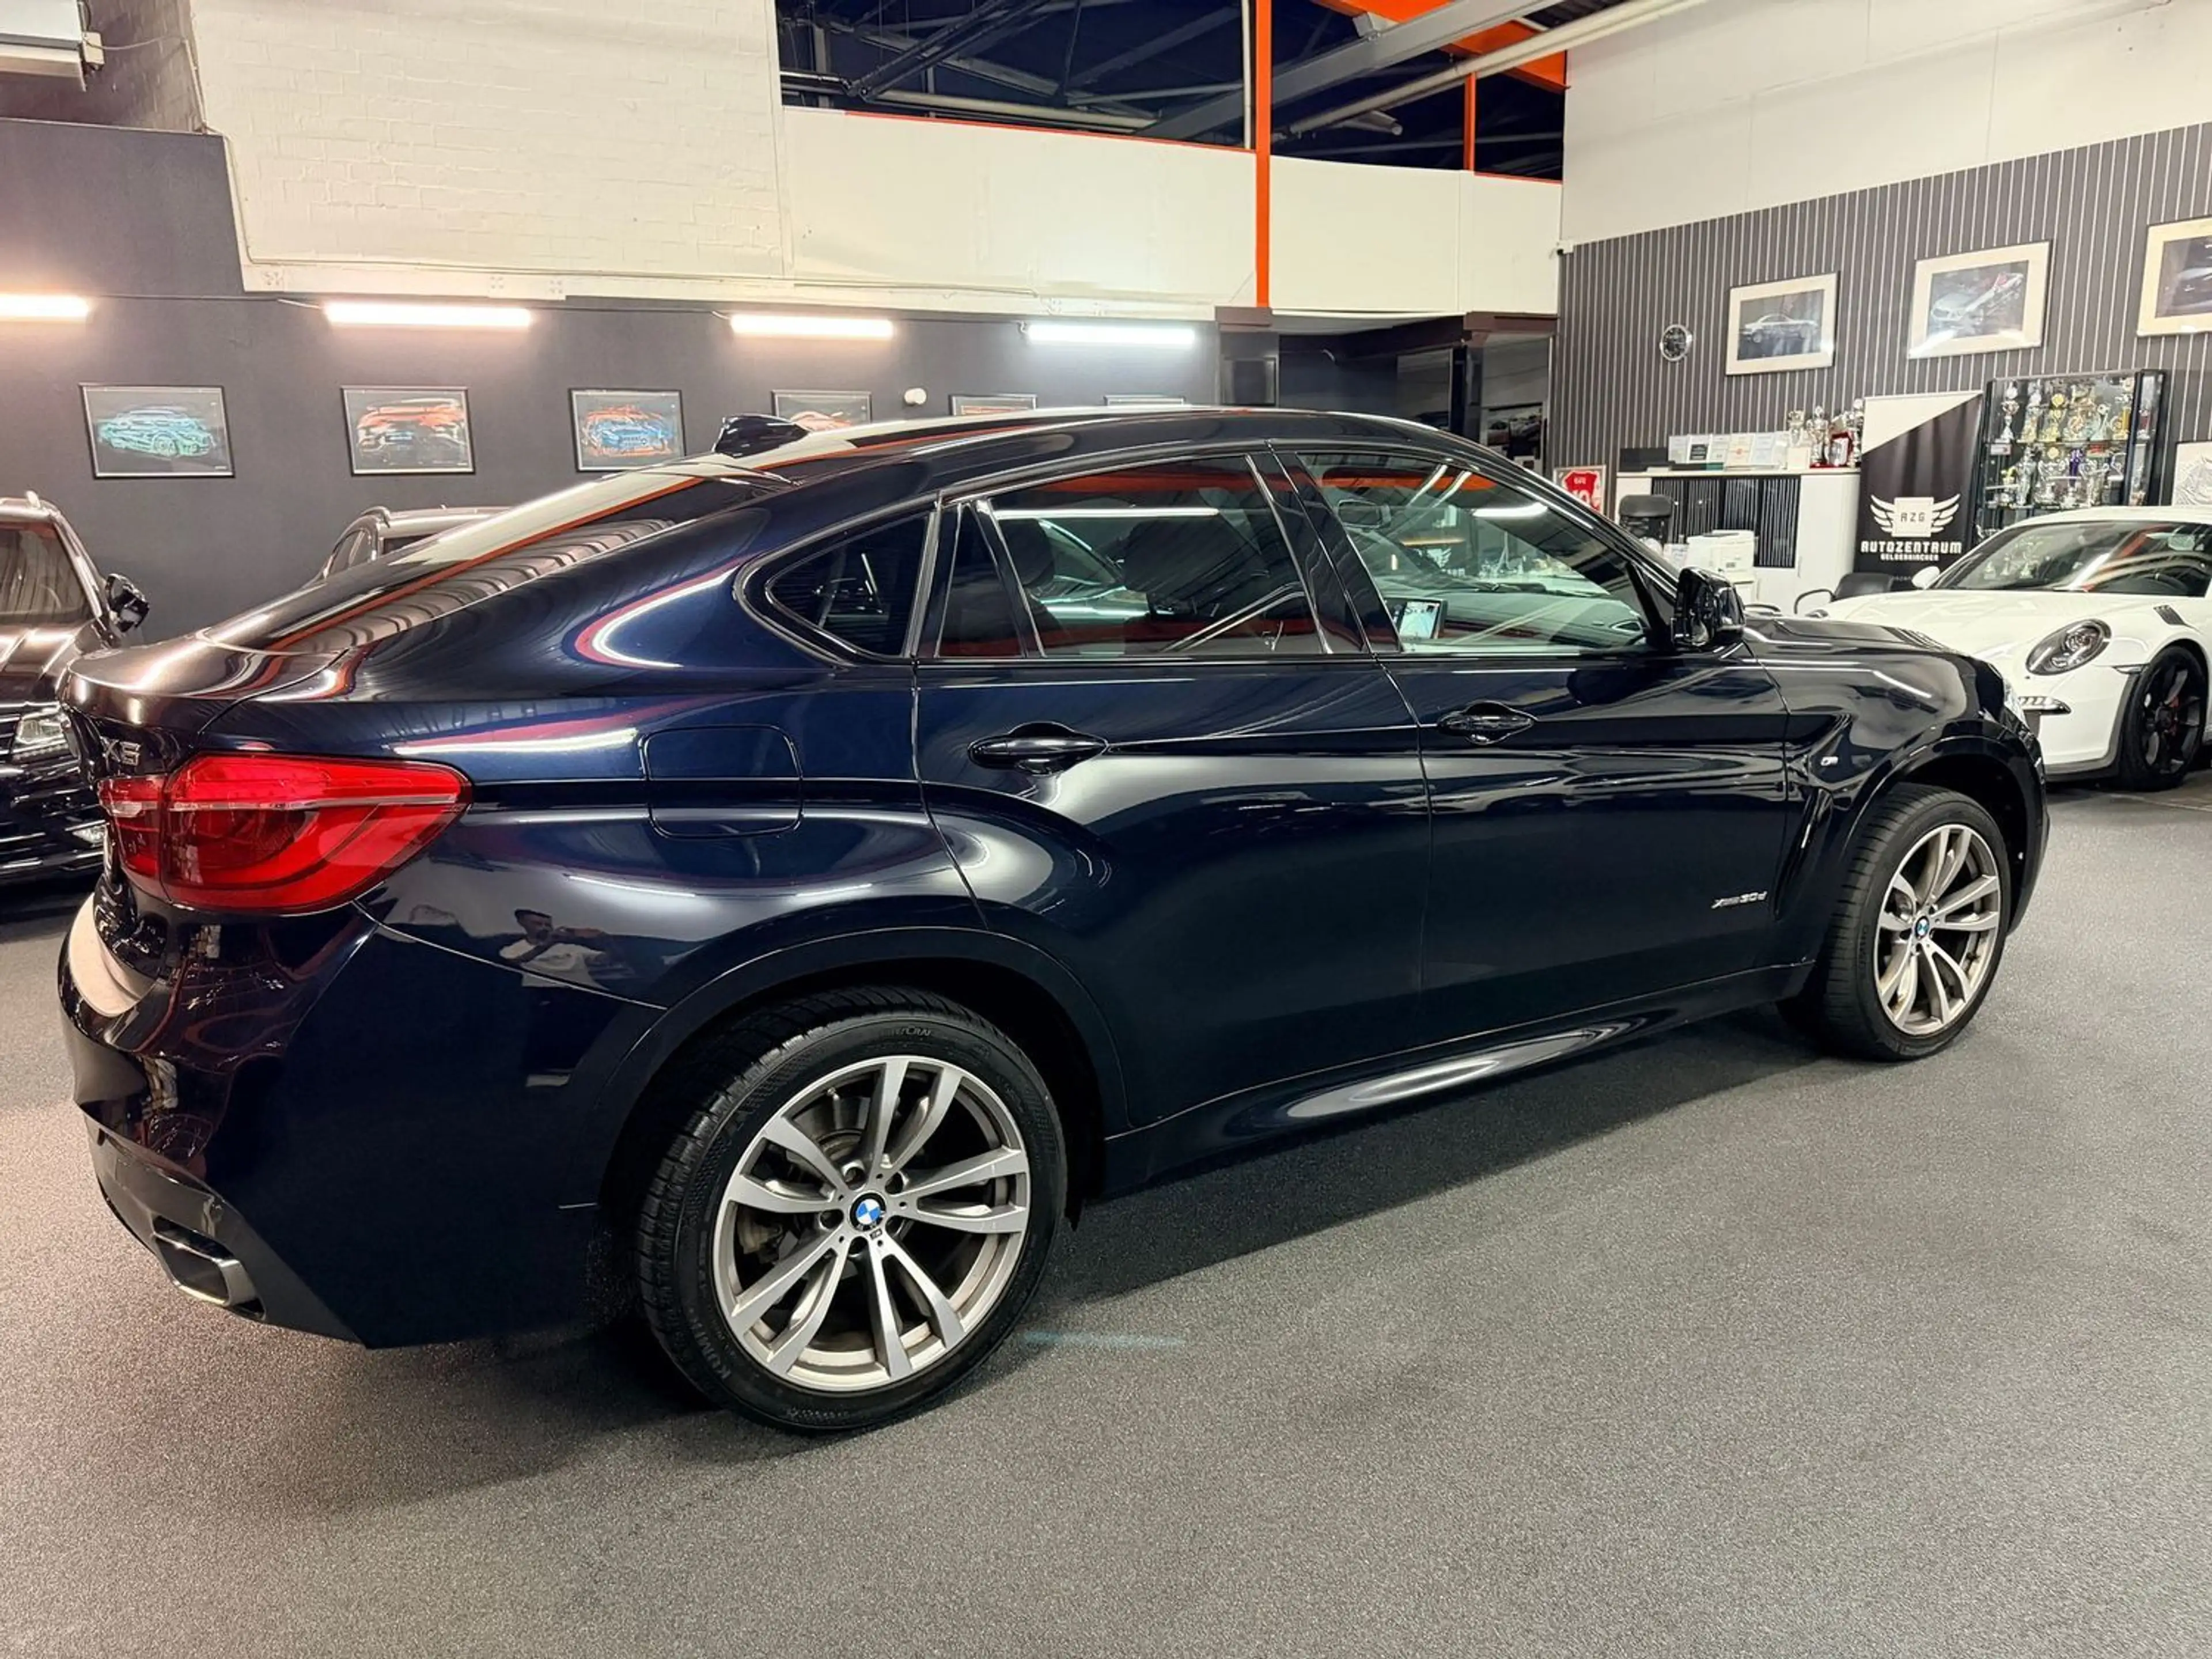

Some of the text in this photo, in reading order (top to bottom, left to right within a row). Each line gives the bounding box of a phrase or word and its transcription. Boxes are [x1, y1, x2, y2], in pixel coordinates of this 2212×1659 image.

[1900, 512, 1926, 522] AZG
[1860, 540, 1963, 554] AUTOZENTRUM
[100, 736, 141, 766] X6
